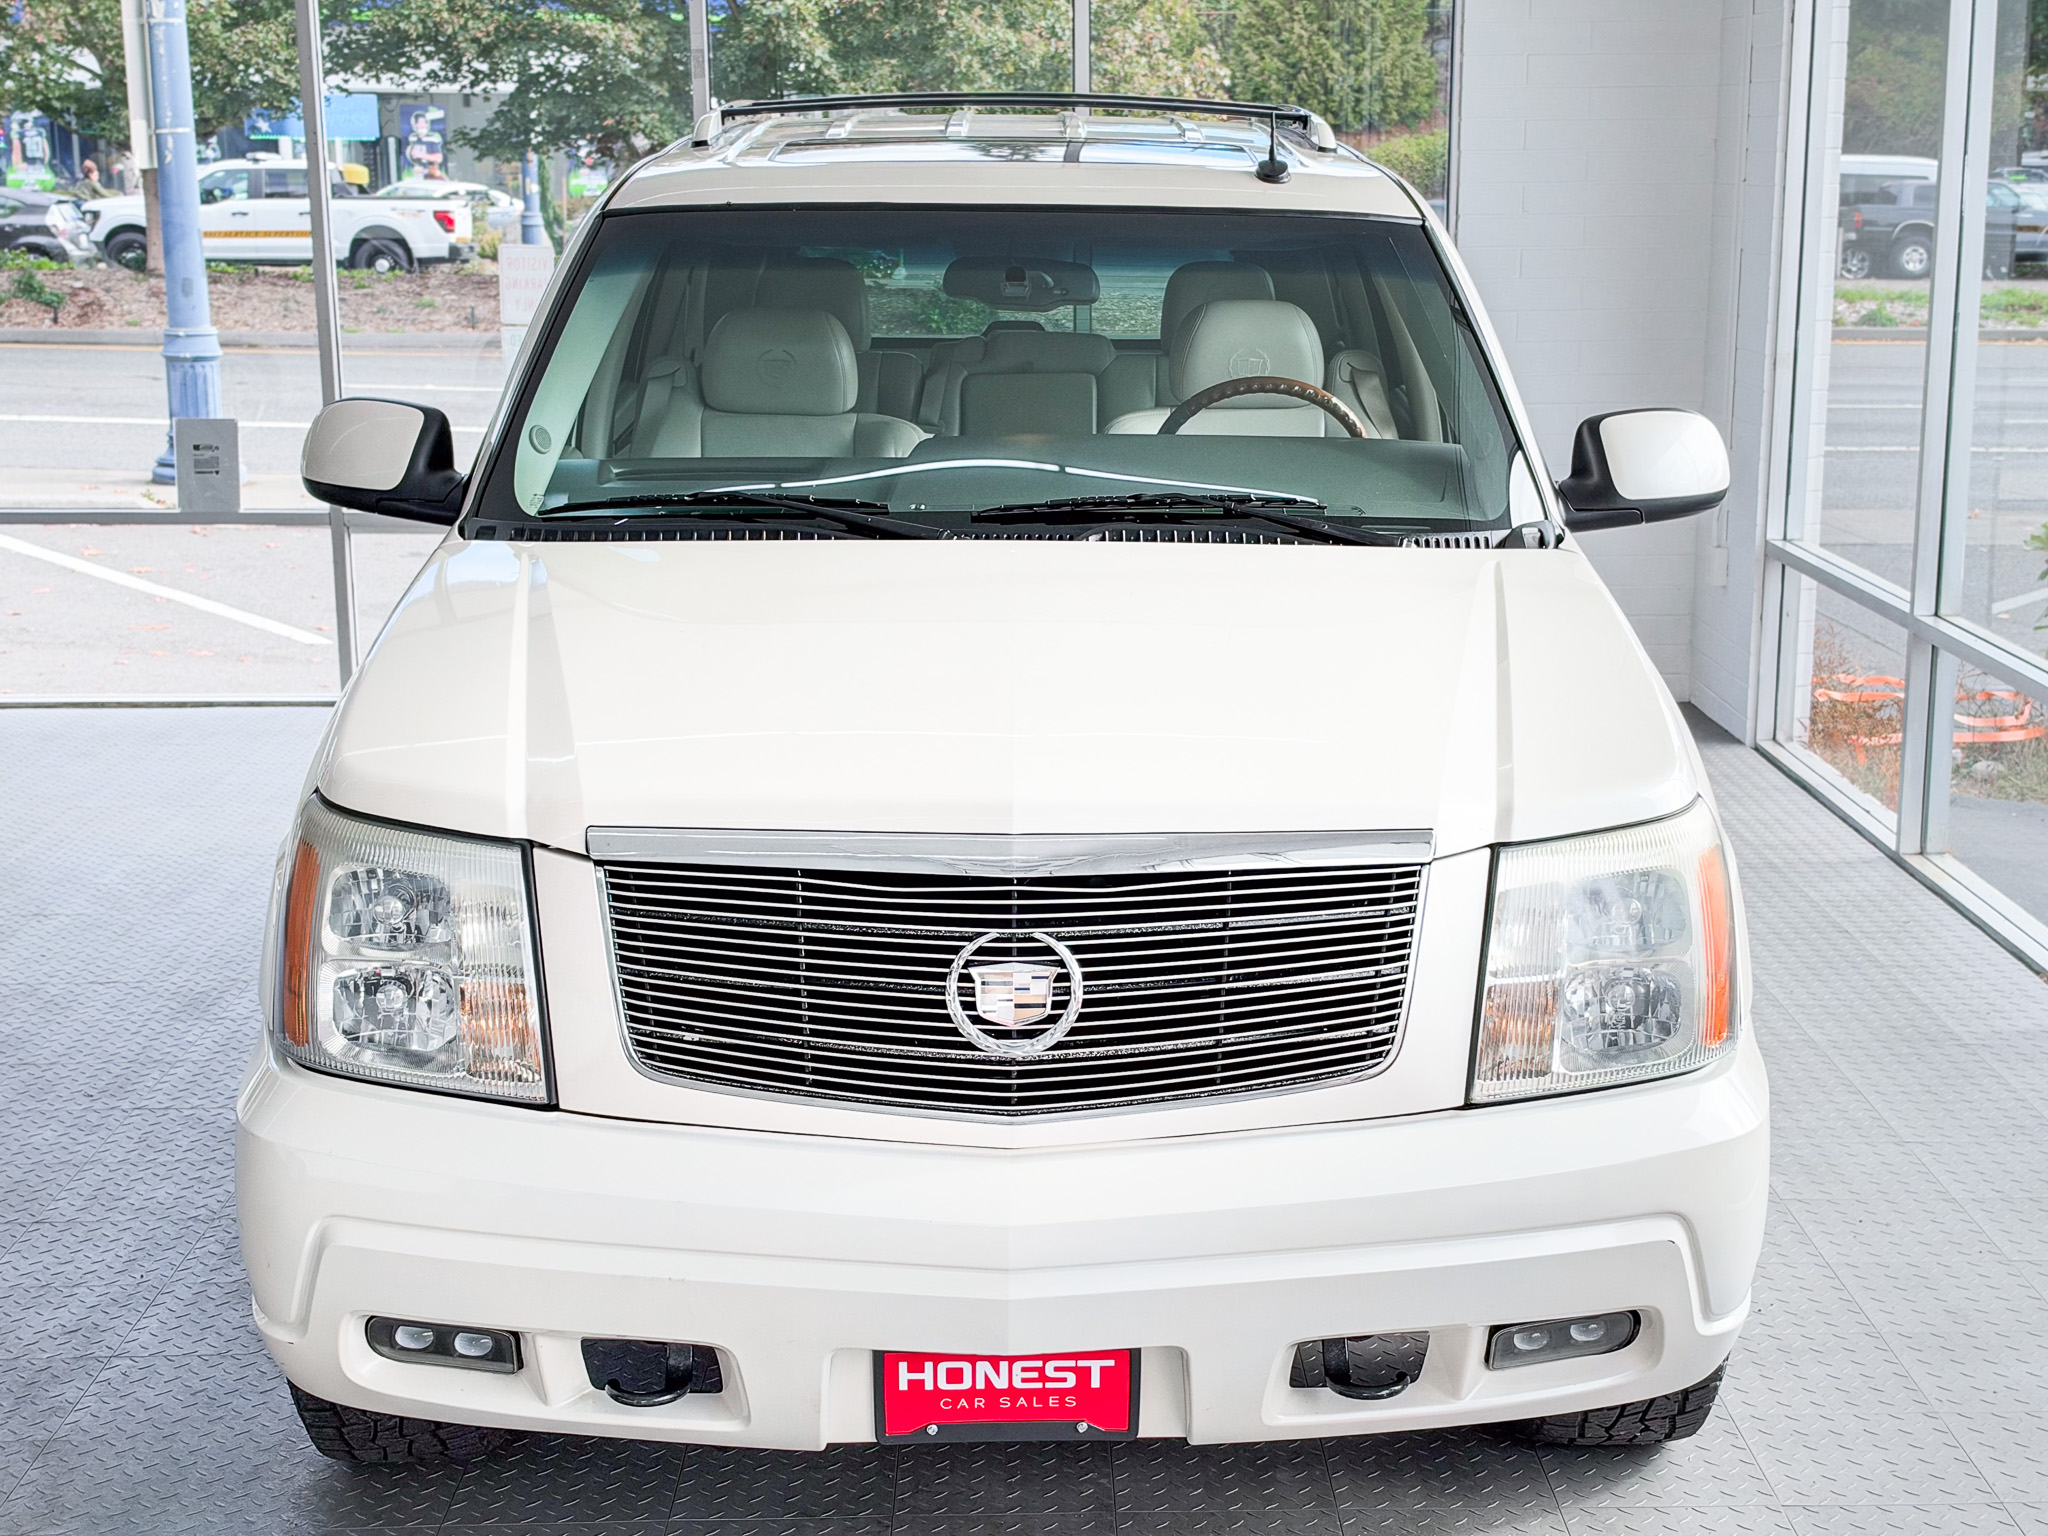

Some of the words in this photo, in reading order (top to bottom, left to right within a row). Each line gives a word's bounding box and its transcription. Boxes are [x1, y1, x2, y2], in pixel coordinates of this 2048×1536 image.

[898, 1359, 1115, 1391] HONEST
[940, 1397, 985, 1410] CAR
[999, 1396, 1077, 1408] SALES
